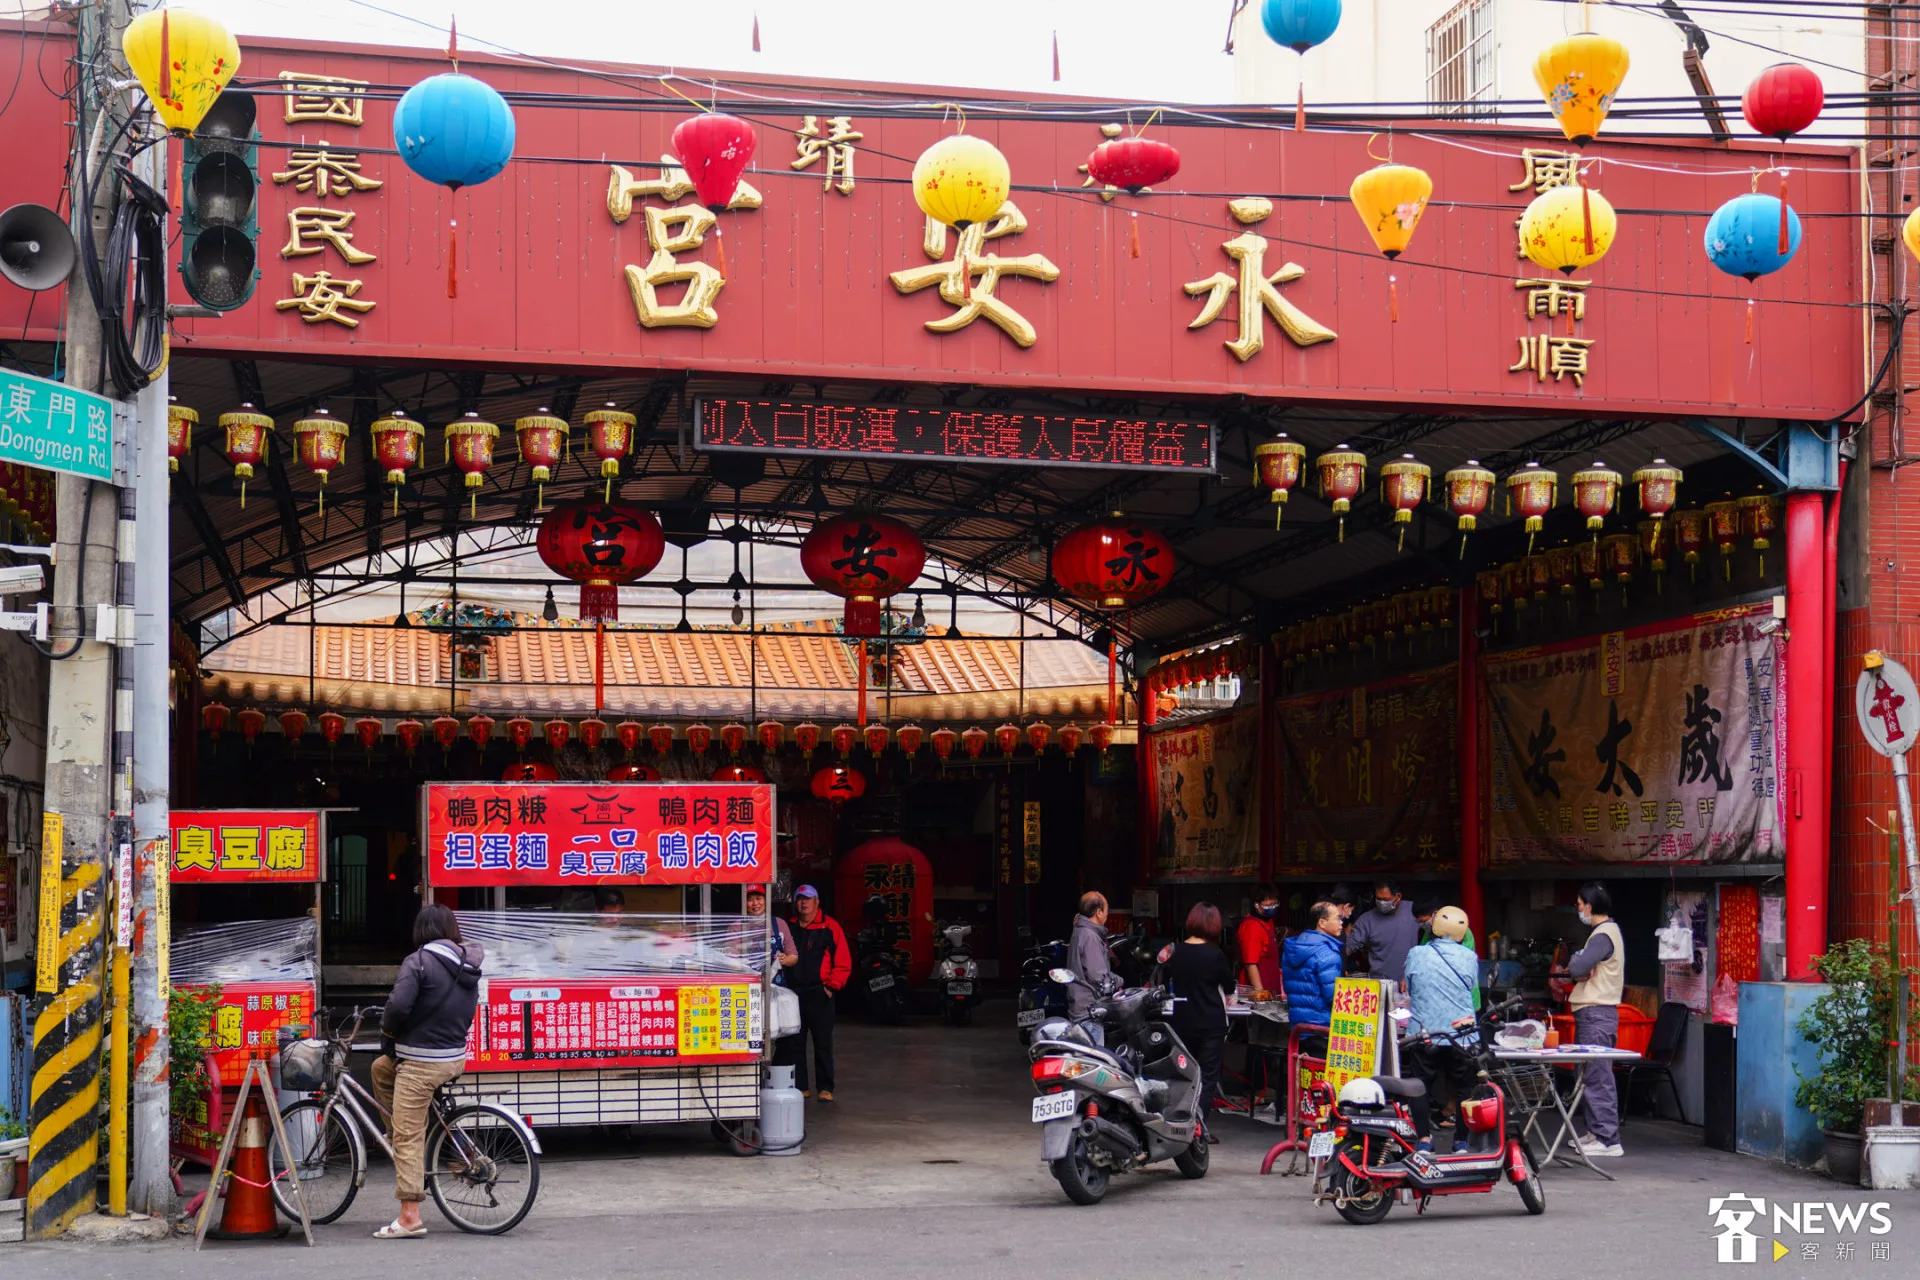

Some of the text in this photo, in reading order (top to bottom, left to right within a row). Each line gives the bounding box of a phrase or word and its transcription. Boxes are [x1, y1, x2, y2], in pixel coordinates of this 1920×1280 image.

[272, 70, 384, 329] 國泰民安
[607, 154, 1338, 363] 永安宮
[1508, 147, 1596, 387] 風雨順
[0, 424, 109, 470] Dongmen Rd.
[573, 505, 642, 566] 宮
[830, 524, 898, 580] 安
[1104, 527, 1160, 586] 永
[659, 796, 755, 826] 鴨肉麵
[175, 825, 306, 872] 臭豆腐
[572, 827, 637, 847] 一口
[658, 830, 758, 869] 鴨肉飯
[559, 850, 647, 876] 臭豆腐
[246, 995, 260, 1045] 蒜味
[261, 995, 274, 1045] 原味
[498, 1003, 509, 1050] 綜合湯
[510, 1003, 521, 1050] 豆腐湯
[557, 1001, 568, 1049] 金針鴨湯
[568, 1001, 579, 1049] 苦瓜鴨湯
[719, 988, 732, 1040] 脆皮臭豆腐
[735, 989, 747, 1040] 一口臭豆腐
[750, 988, 761, 1037] 鴨肉米糕
[1332, 1019, 1365, 1037] 高麗菜包
[480, 1053, 491, 1061] 50
[498, 1052, 509, 1061] 20
[512, 1052, 523, 1060] 20
[1034, 1098, 1073, 1119] 753-GTG
